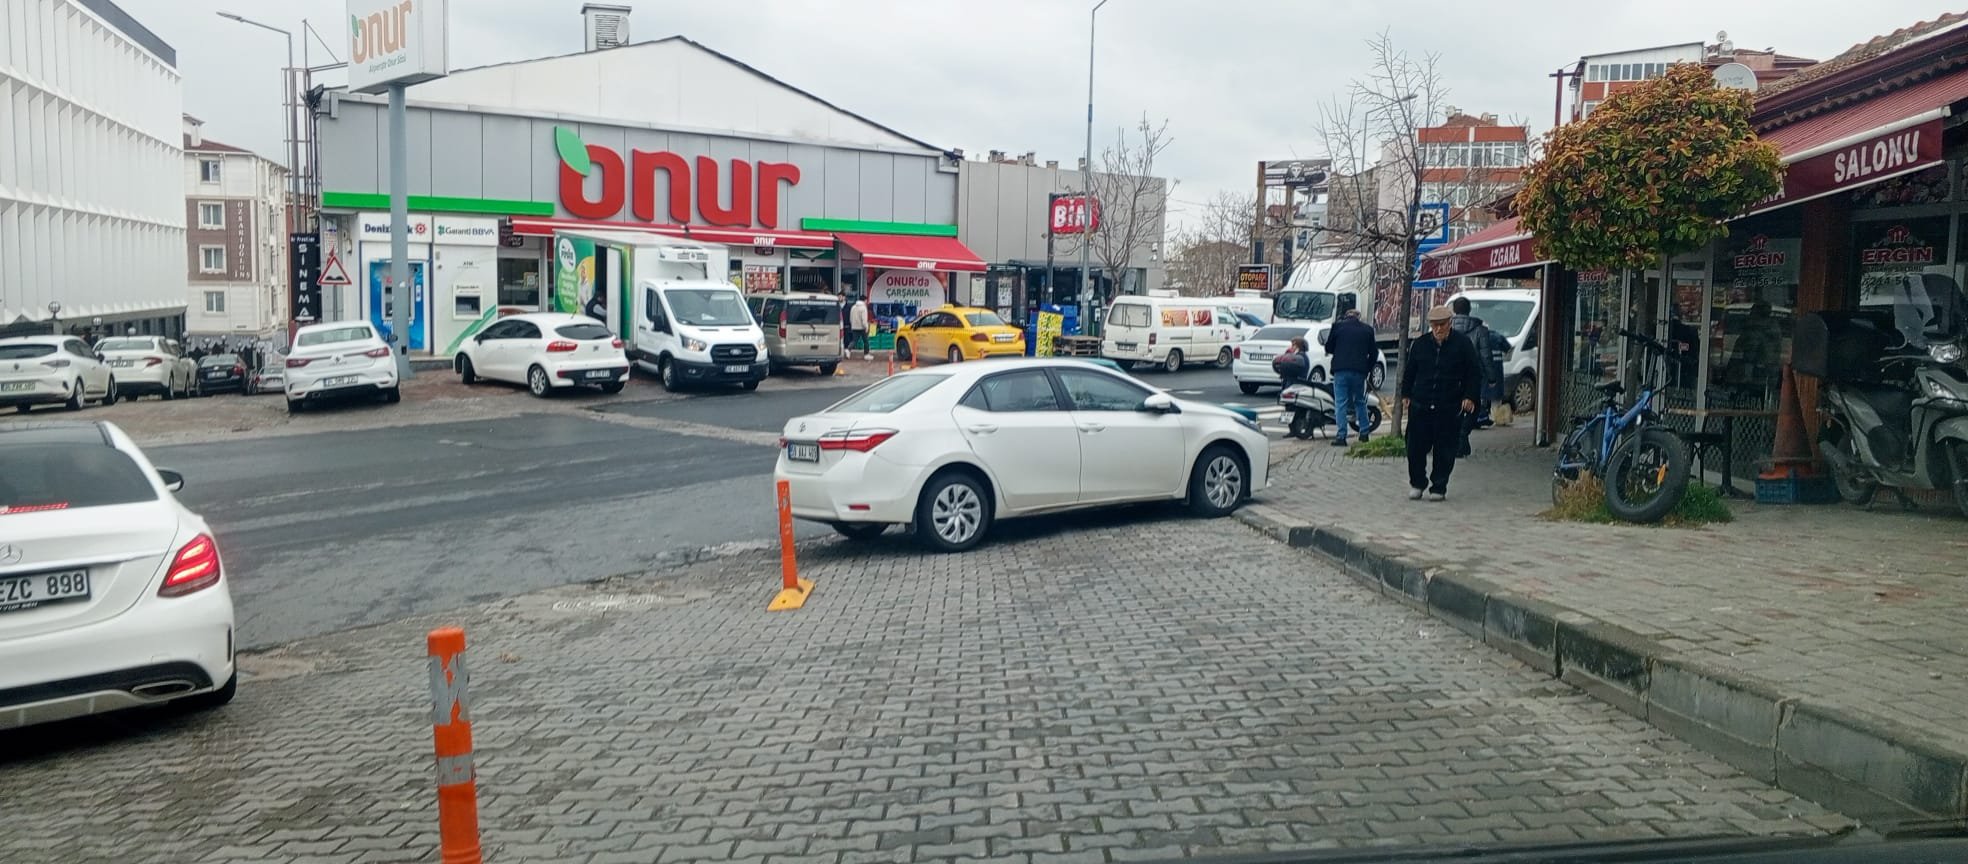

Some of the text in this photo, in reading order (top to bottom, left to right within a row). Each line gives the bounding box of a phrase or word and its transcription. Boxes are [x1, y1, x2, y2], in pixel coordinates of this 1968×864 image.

[1834, 131, 1919, 183] SALONU
[554, 126, 800, 229] onur
[472, 228, 495, 236] BBVA
[754, 236, 776, 246] onur
[1735, 252, 1785, 269] ERGIN
[1862, 247, 1933, 265] ERGIN
[917, 262, 936, 271] onur
[47, 572, 85, 596] 898
